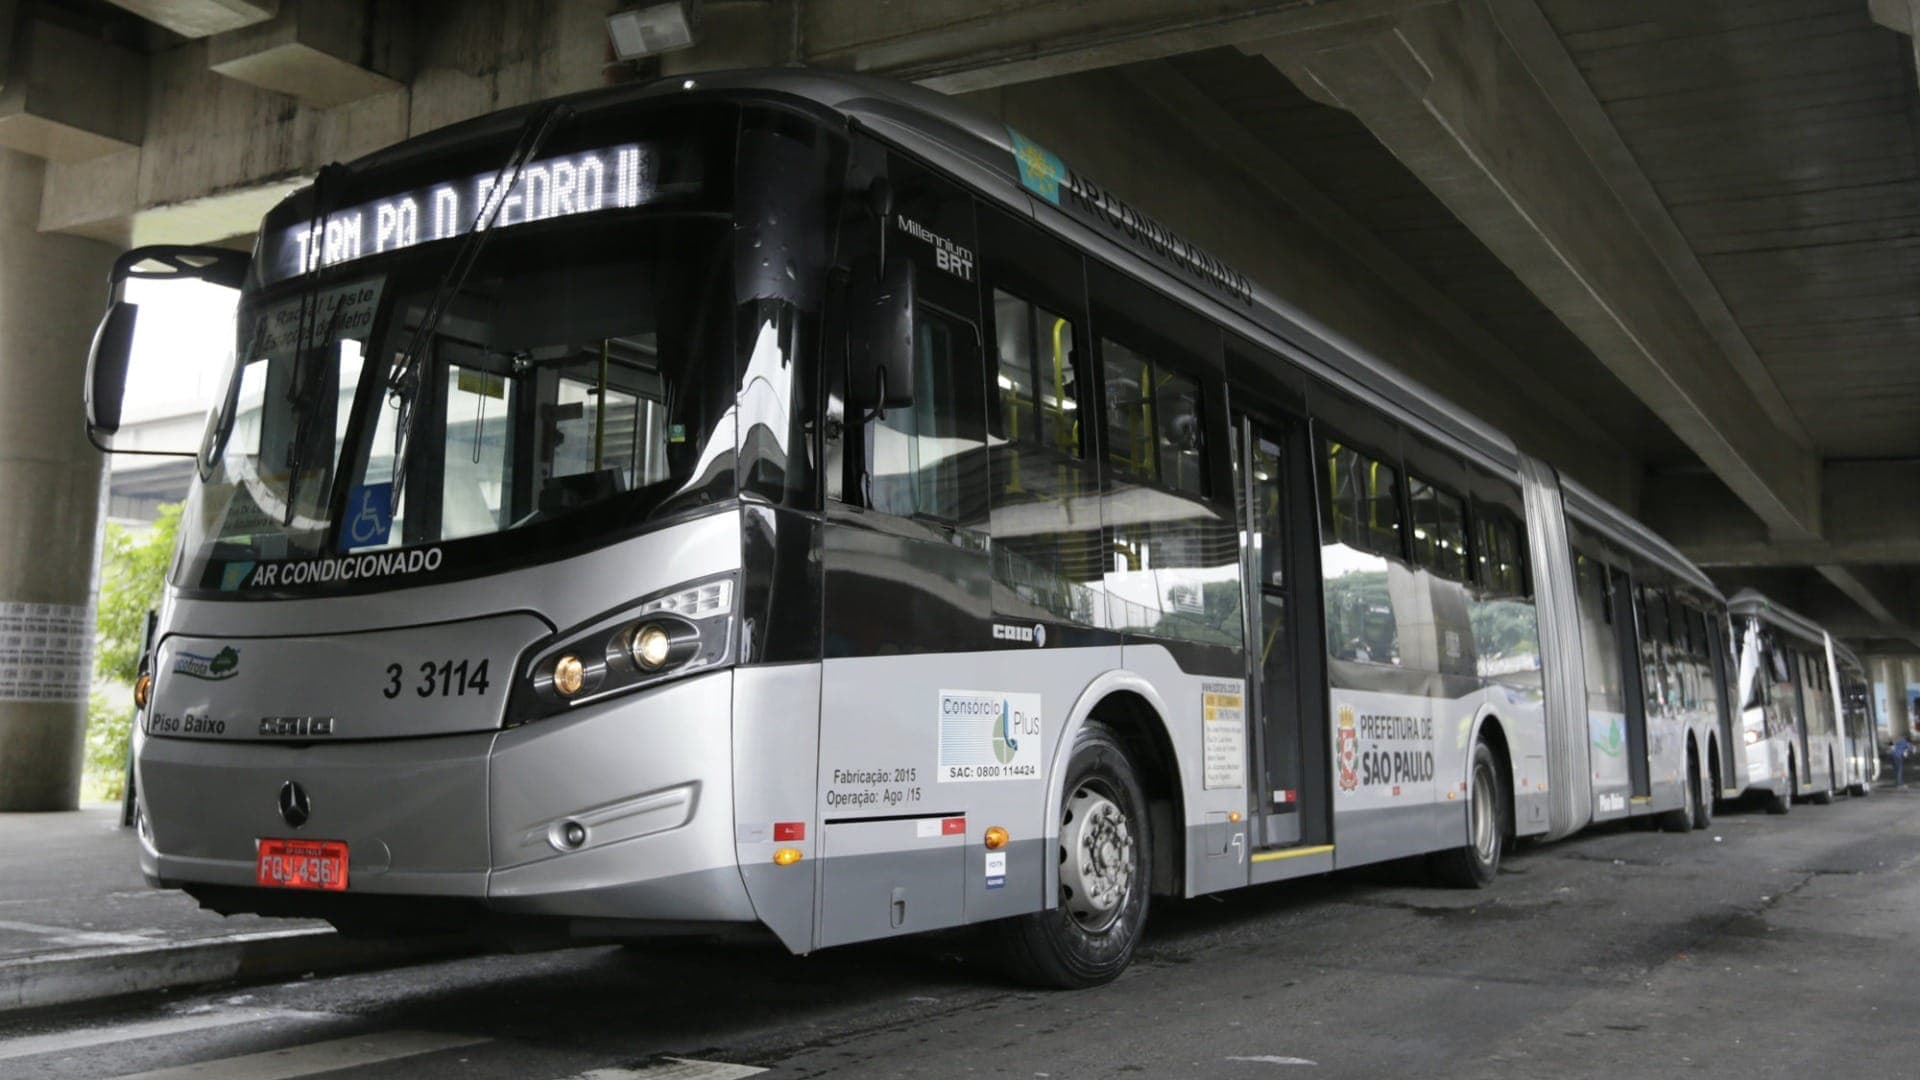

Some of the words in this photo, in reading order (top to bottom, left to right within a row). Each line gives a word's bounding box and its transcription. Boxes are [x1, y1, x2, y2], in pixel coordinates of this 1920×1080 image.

[476, 156, 603, 232] PEDRO
[898, 214, 974, 262] Millennium
[1069, 168, 1106, 222] AR
[1104, 191, 1253, 307] CONDICIONADO
[936, 247, 974, 281] BRT
[251, 564, 277, 587] AR
[281, 547, 443, 584] CONDICIONADO
[383, 662, 403, 699] 3
[416, 658, 490, 698] 3114
[943, 698, 1001, 716] Consórcio
[152, 714, 180, 733] Piso
[184, 714, 226, 735] Baixo
[1013, 711, 1040, 736] Plus
[1360, 714, 1419, 740] PREFEITURA
[1420, 717, 1433, 740] DE
[833, 768, 893, 787] Fabricação:
[894, 768, 917, 783] 2015
[950, 767, 974, 778] SAC:
[976, 766, 1000, 777] 0800
[1003, 765, 1035, 776] 114424
[1362, 744, 1391, 786] SÃO
[1393, 751, 1435, 784] PAULO
[826, 789, 879, 808] Operação:
[883, 789, 903, 806] Ago
